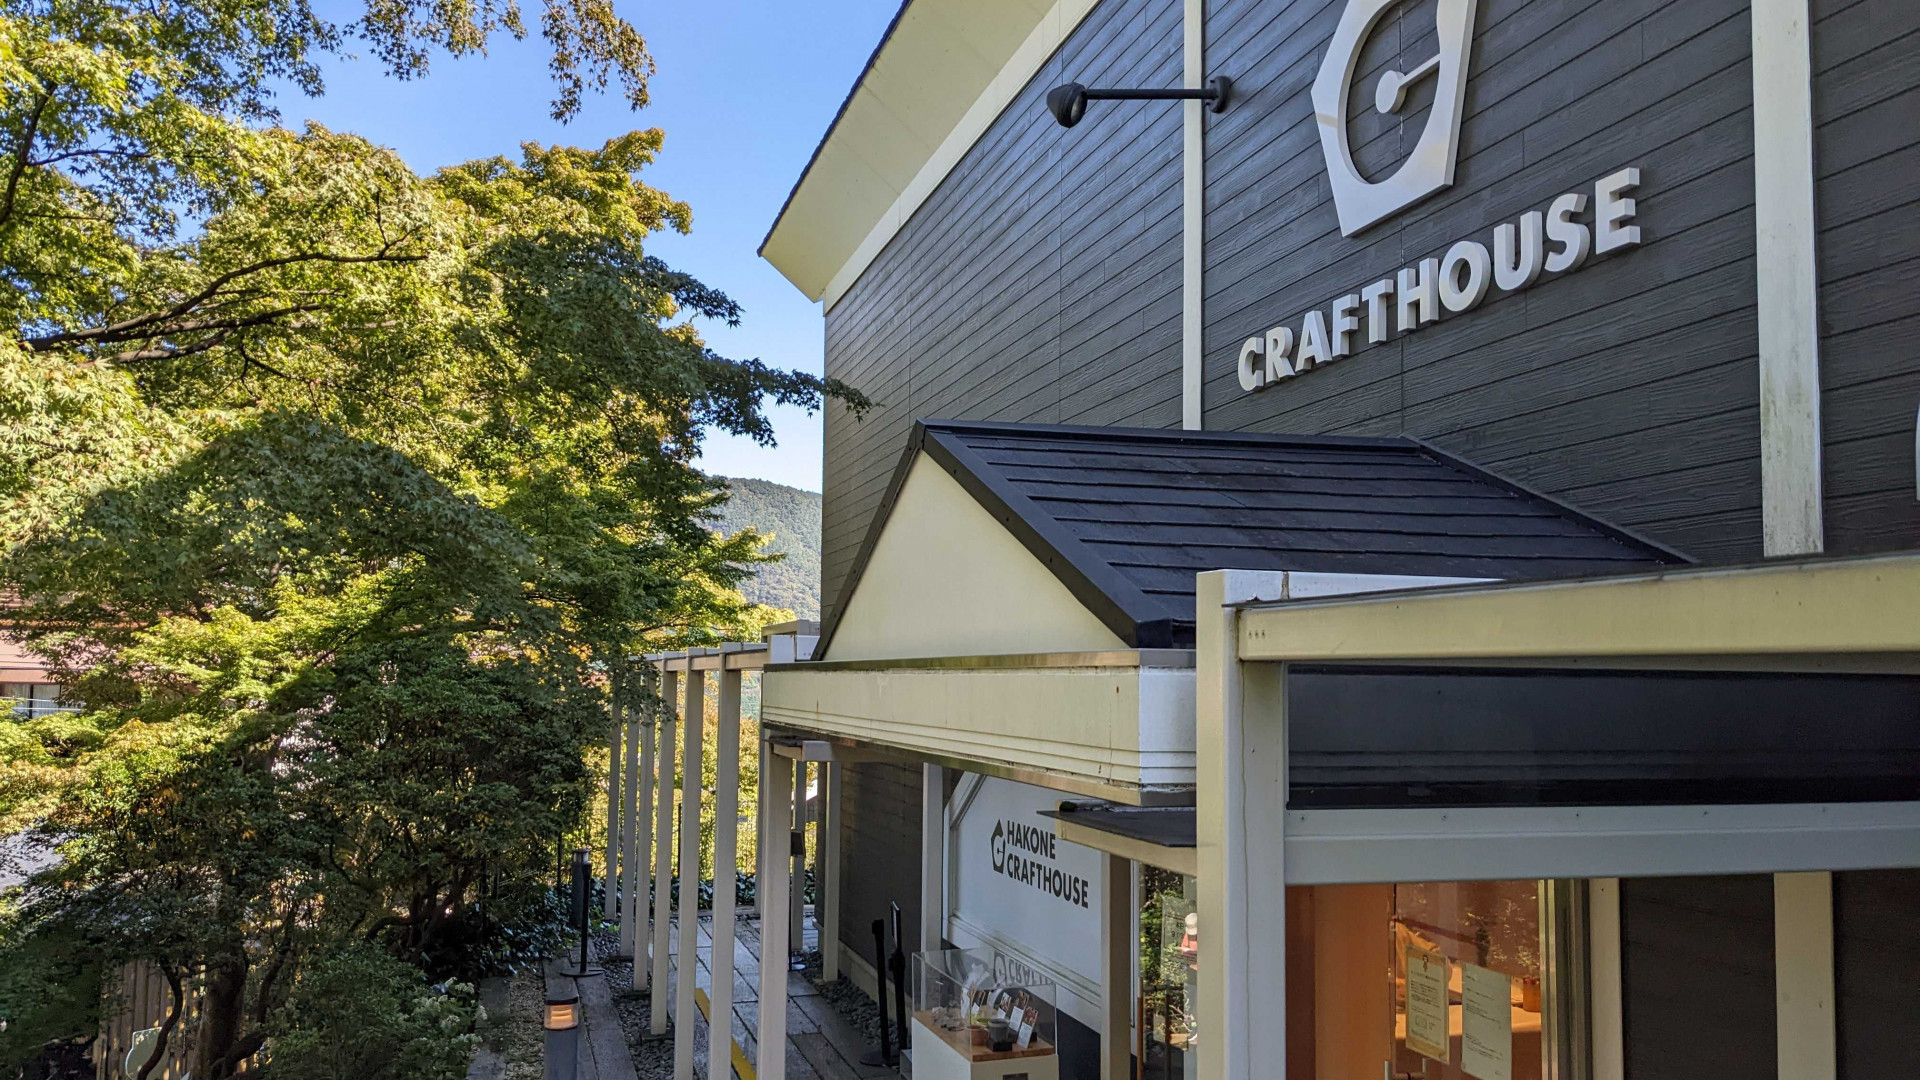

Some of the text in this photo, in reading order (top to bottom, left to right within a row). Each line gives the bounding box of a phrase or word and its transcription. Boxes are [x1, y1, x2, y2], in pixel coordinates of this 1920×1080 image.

[1238, 167, 1641, 391] CRAFTHOUSE
[1007, 820, 1056, 860] HAKONE
[1007, 852, 1089, 909] CRAFTHOUSE
